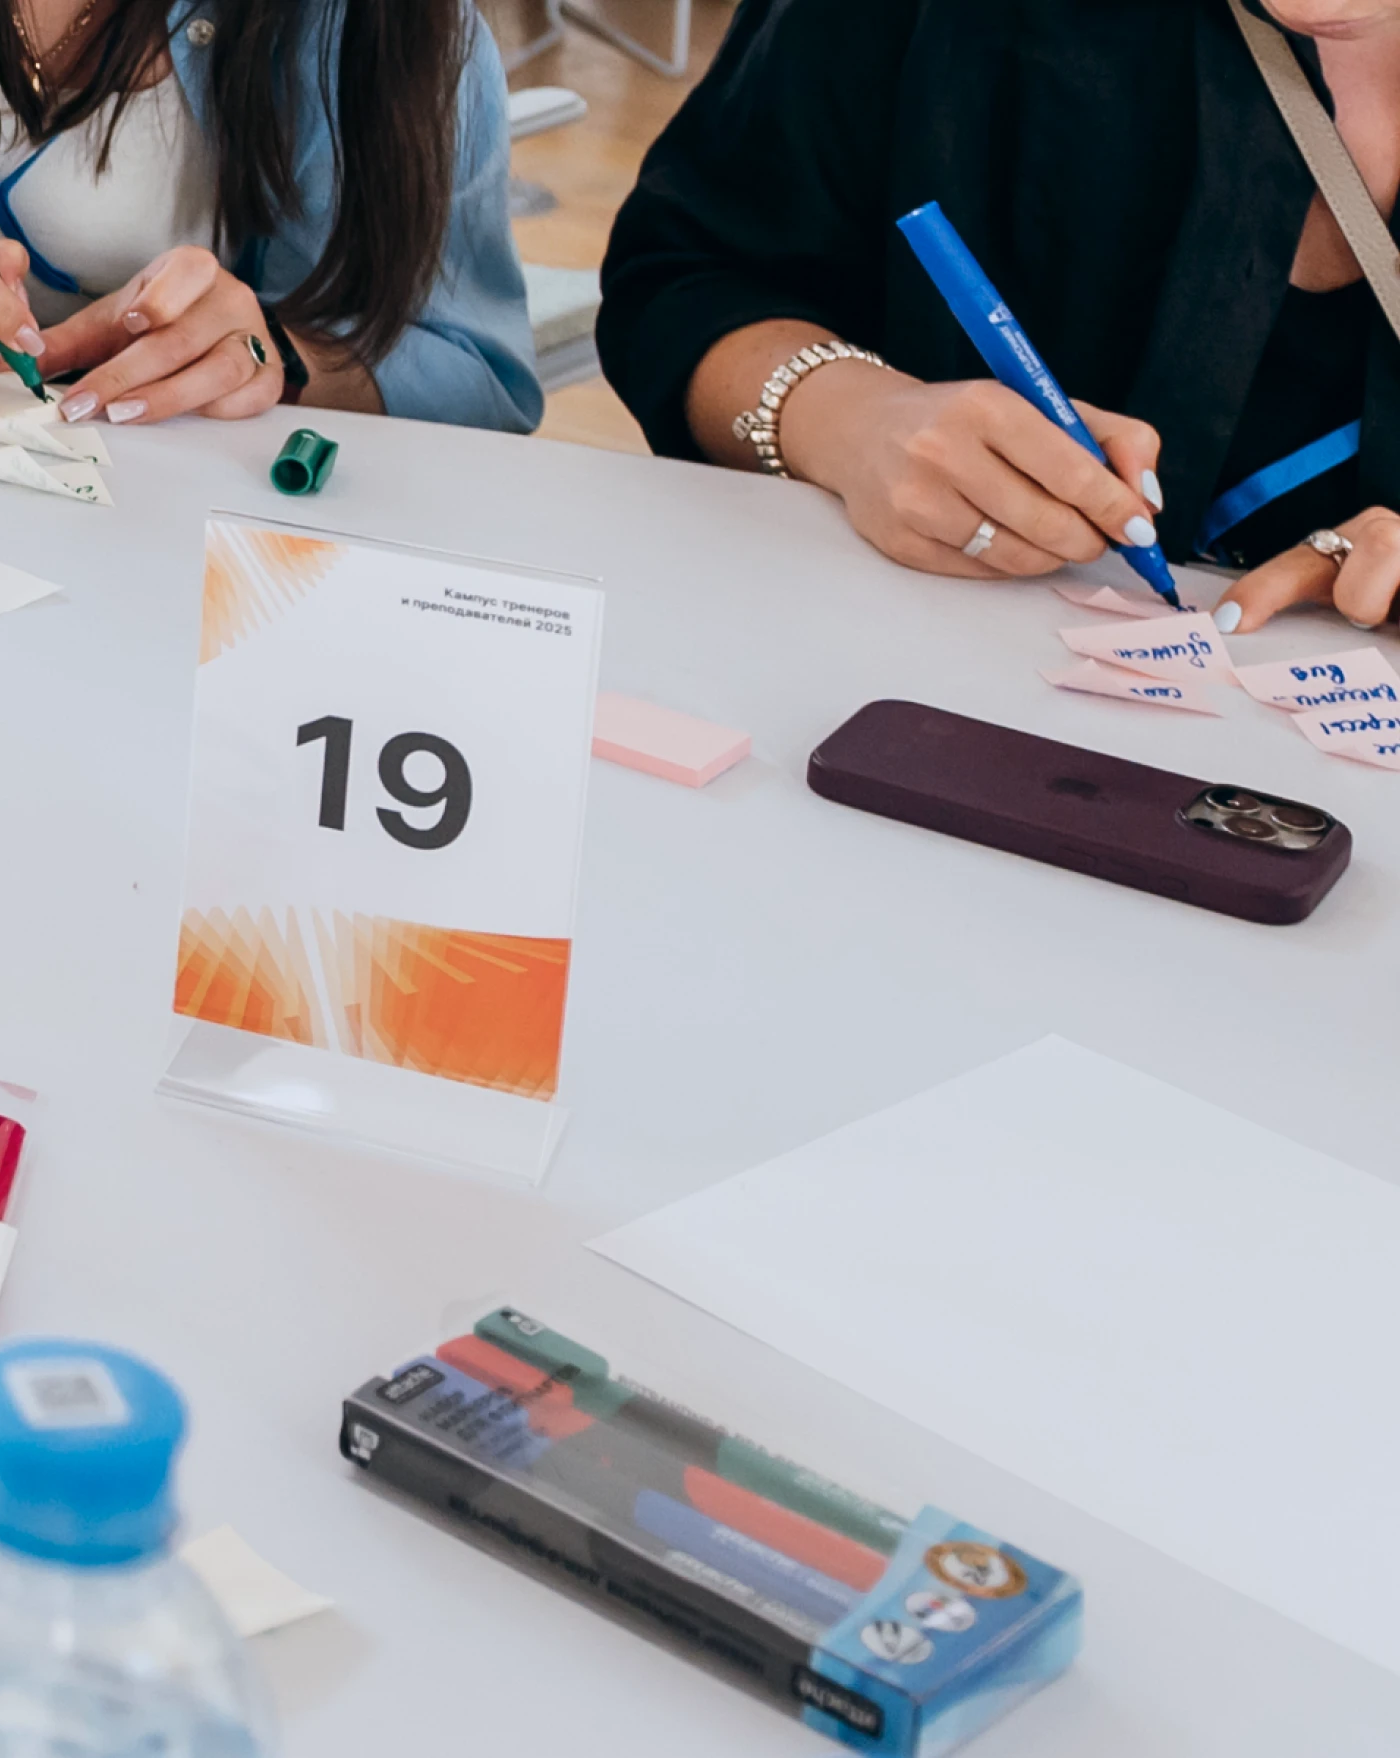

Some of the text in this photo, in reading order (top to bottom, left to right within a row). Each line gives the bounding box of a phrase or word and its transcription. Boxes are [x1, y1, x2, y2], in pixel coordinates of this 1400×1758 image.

[401, 597, 572, 637] и преподавателей 2025
[444, 587, 571, 621] Кампус тренеров
[1321, 712, 1400, 734] ересы
[296, 715, 472, 851] 19
